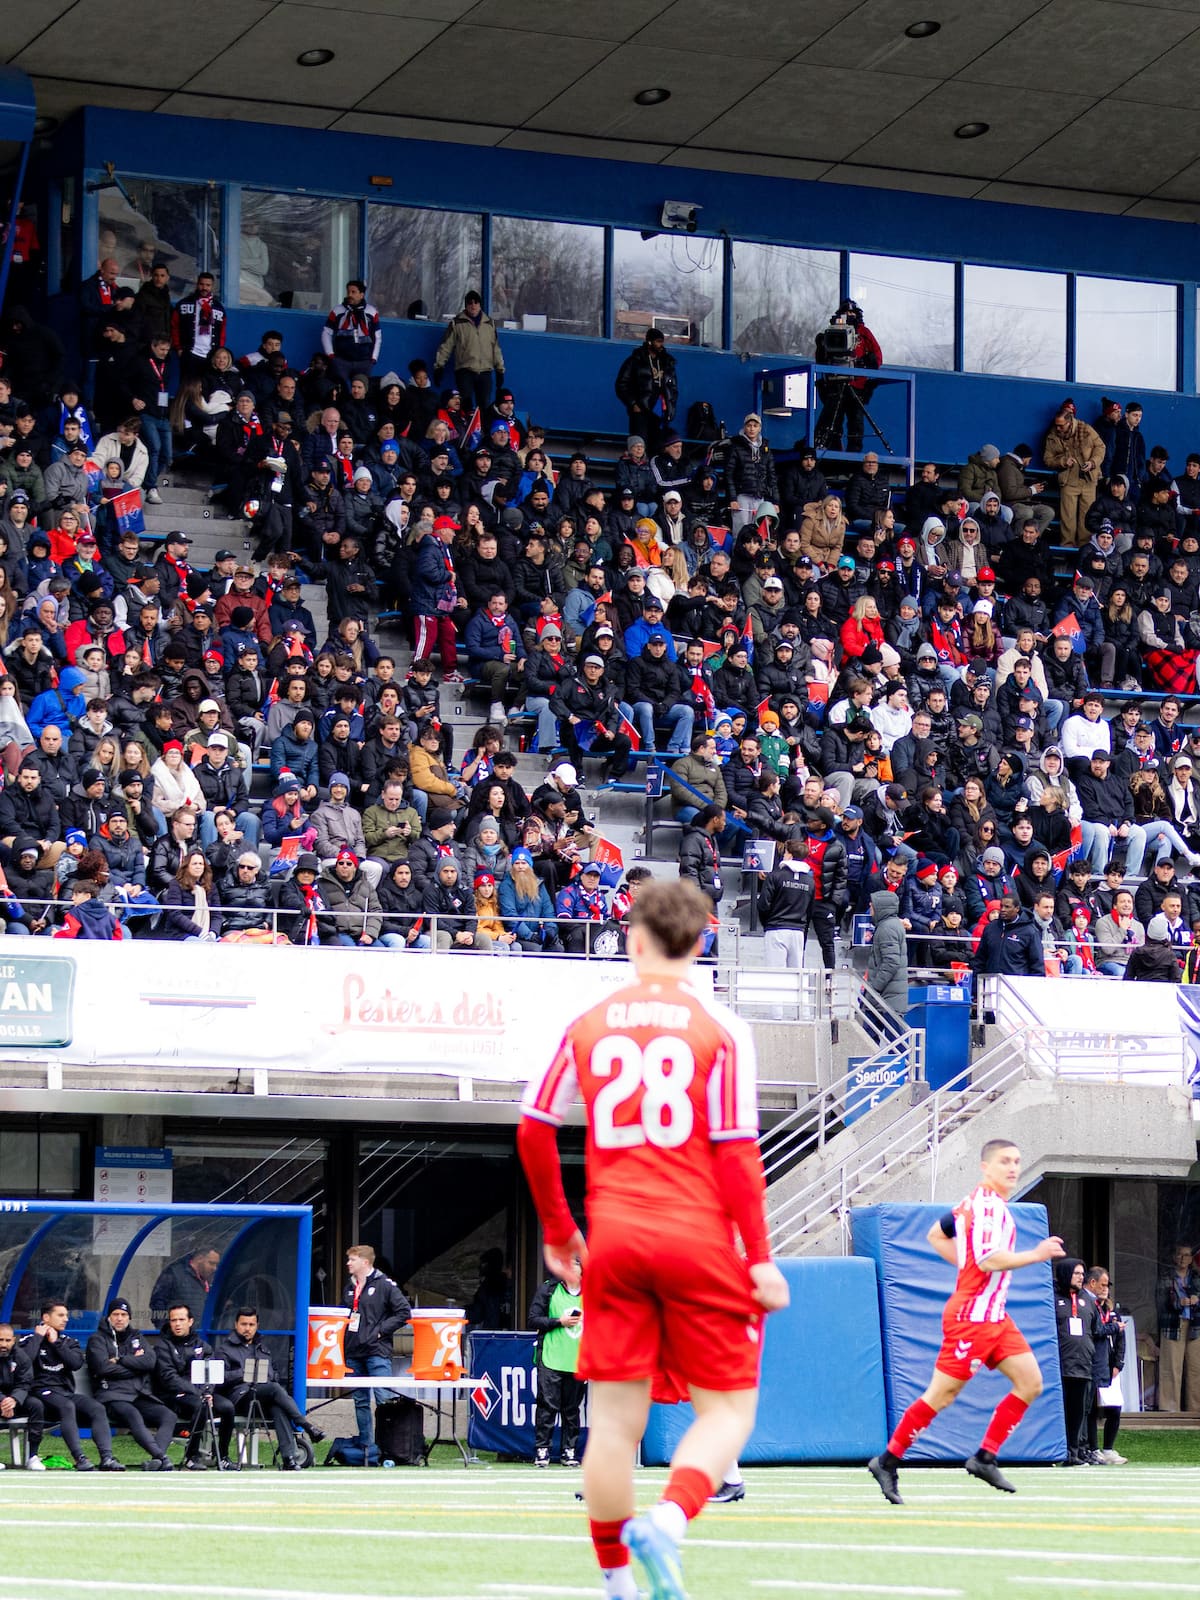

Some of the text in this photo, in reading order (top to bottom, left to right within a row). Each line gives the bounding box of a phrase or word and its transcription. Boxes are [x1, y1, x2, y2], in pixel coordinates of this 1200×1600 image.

[181, 304, 194, 314] SU
[590, 1035, 695, 1149] 28
[318, 1324, 338, 1347] G
[440, 1324, 460, 1348] G
[501, 1367, 526, 1426] FC
